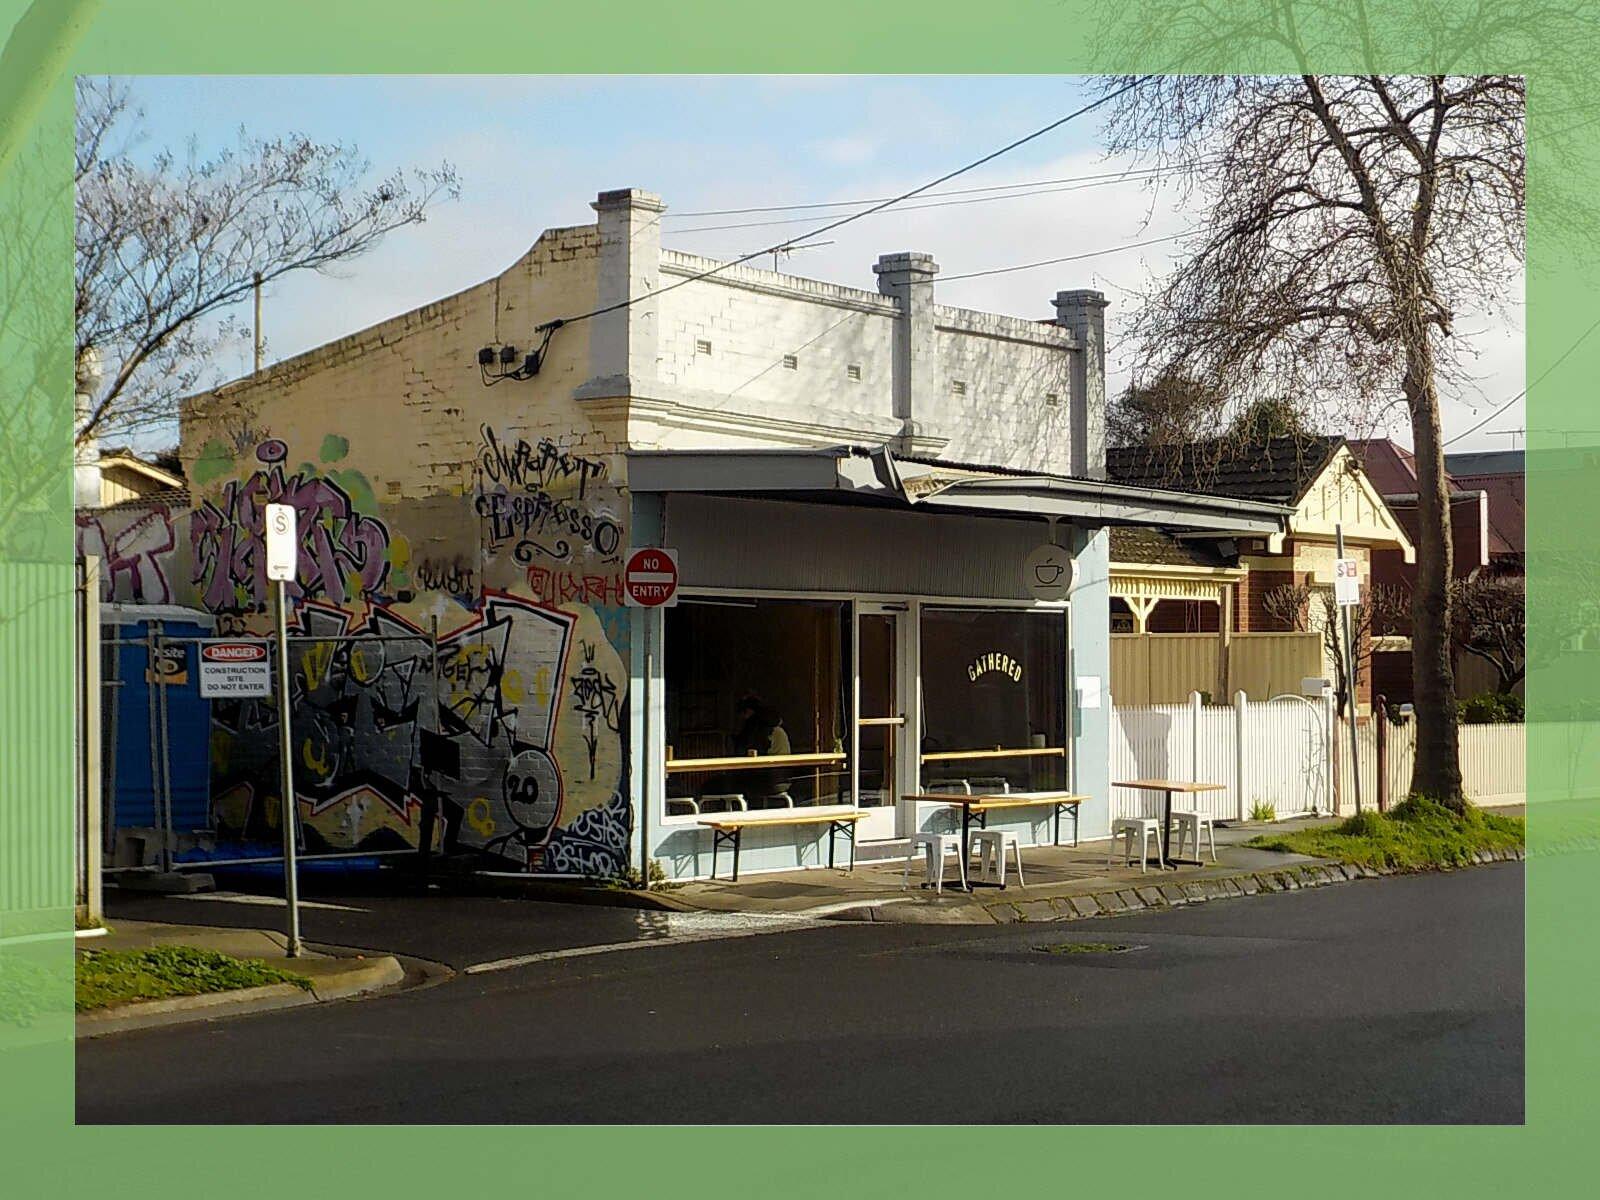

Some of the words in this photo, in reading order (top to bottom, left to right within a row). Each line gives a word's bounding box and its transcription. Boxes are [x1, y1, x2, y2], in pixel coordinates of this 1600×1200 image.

[275, 515, 287, 533] S
[643, 557, 660, 570] NO
[632, 585, 671, 597] ENTRY
[211, 648, 258, 658] DANGER
[967, 652, 1023, 683] GATHERED
[226, 675, 244, 683] SITE
